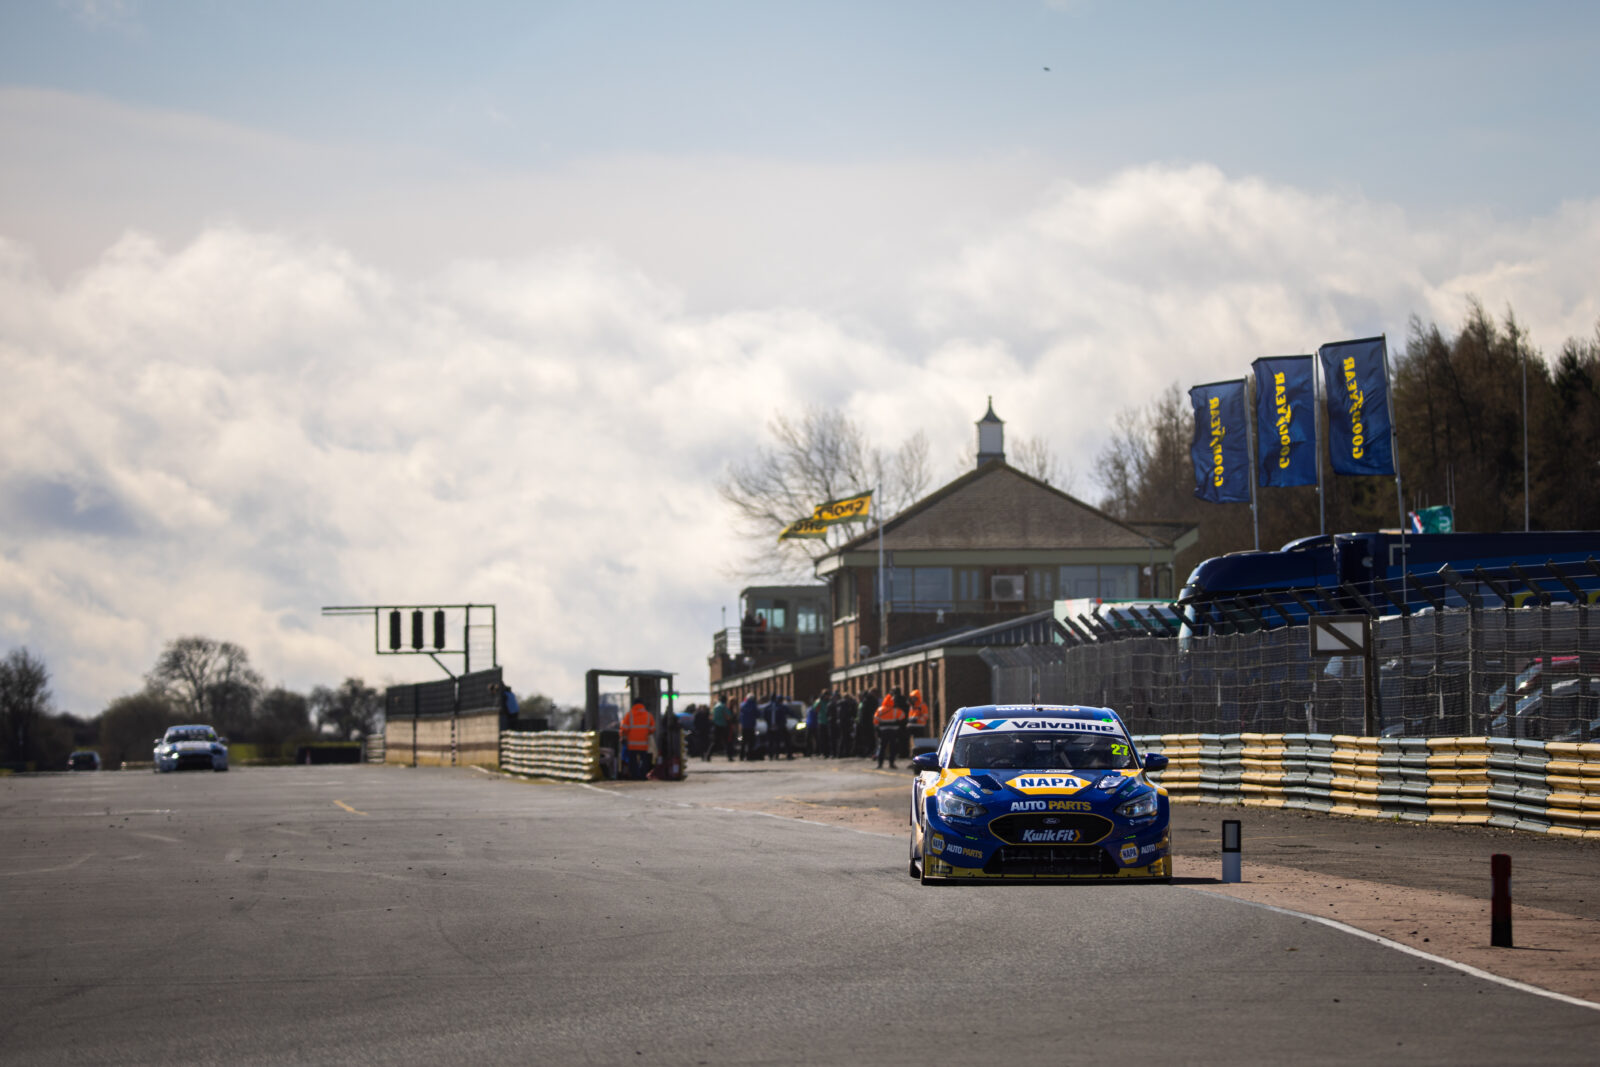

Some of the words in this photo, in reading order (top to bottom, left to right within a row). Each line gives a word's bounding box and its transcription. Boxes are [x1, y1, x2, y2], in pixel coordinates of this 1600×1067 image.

[1012, 721, 1114, 732] Valvoline
[1111, 743, 1129, 755] 27
[1021, 778, 1078, 788] NAPA
[1010, 801, 1046, 811] AUTO
[1048, 800, 1091, 811] PARTS
[946, 843, 963, 854] AUTO
[963, 847, 983, 859] PARTS
[1122, 847, 1137, 859] NAPA
[1141, 844, 1156, 854] AUTO
